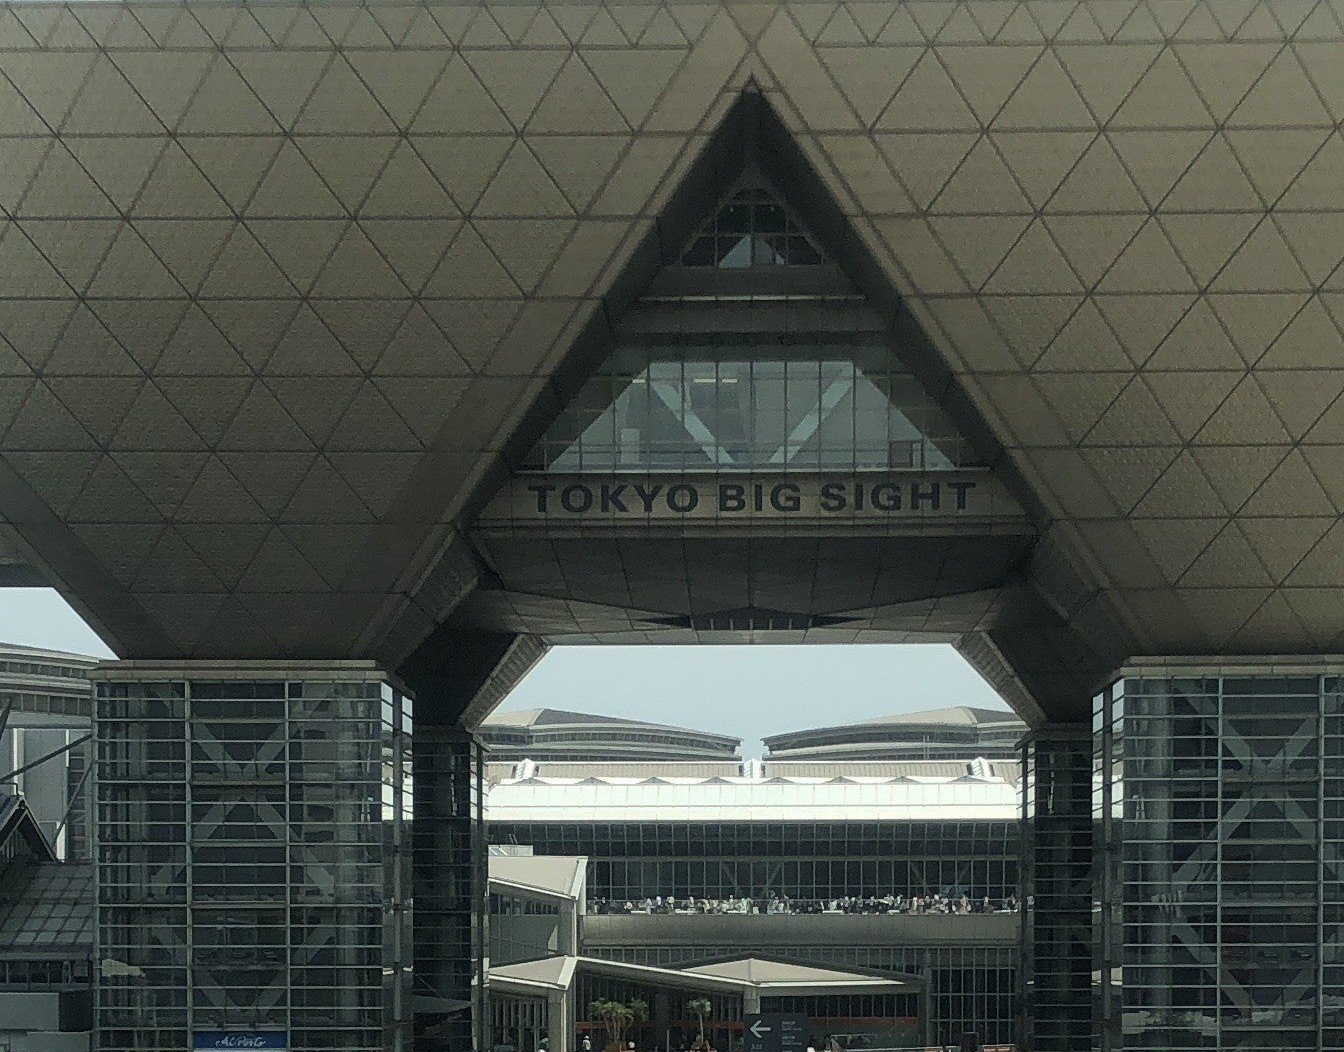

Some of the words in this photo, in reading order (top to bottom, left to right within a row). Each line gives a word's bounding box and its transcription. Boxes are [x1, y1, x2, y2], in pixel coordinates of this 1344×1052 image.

[527, 483, 699, 514] TOKYO
[717, 482, 802, 513] BIG
[820, 481, 977, 512] SIGHT
